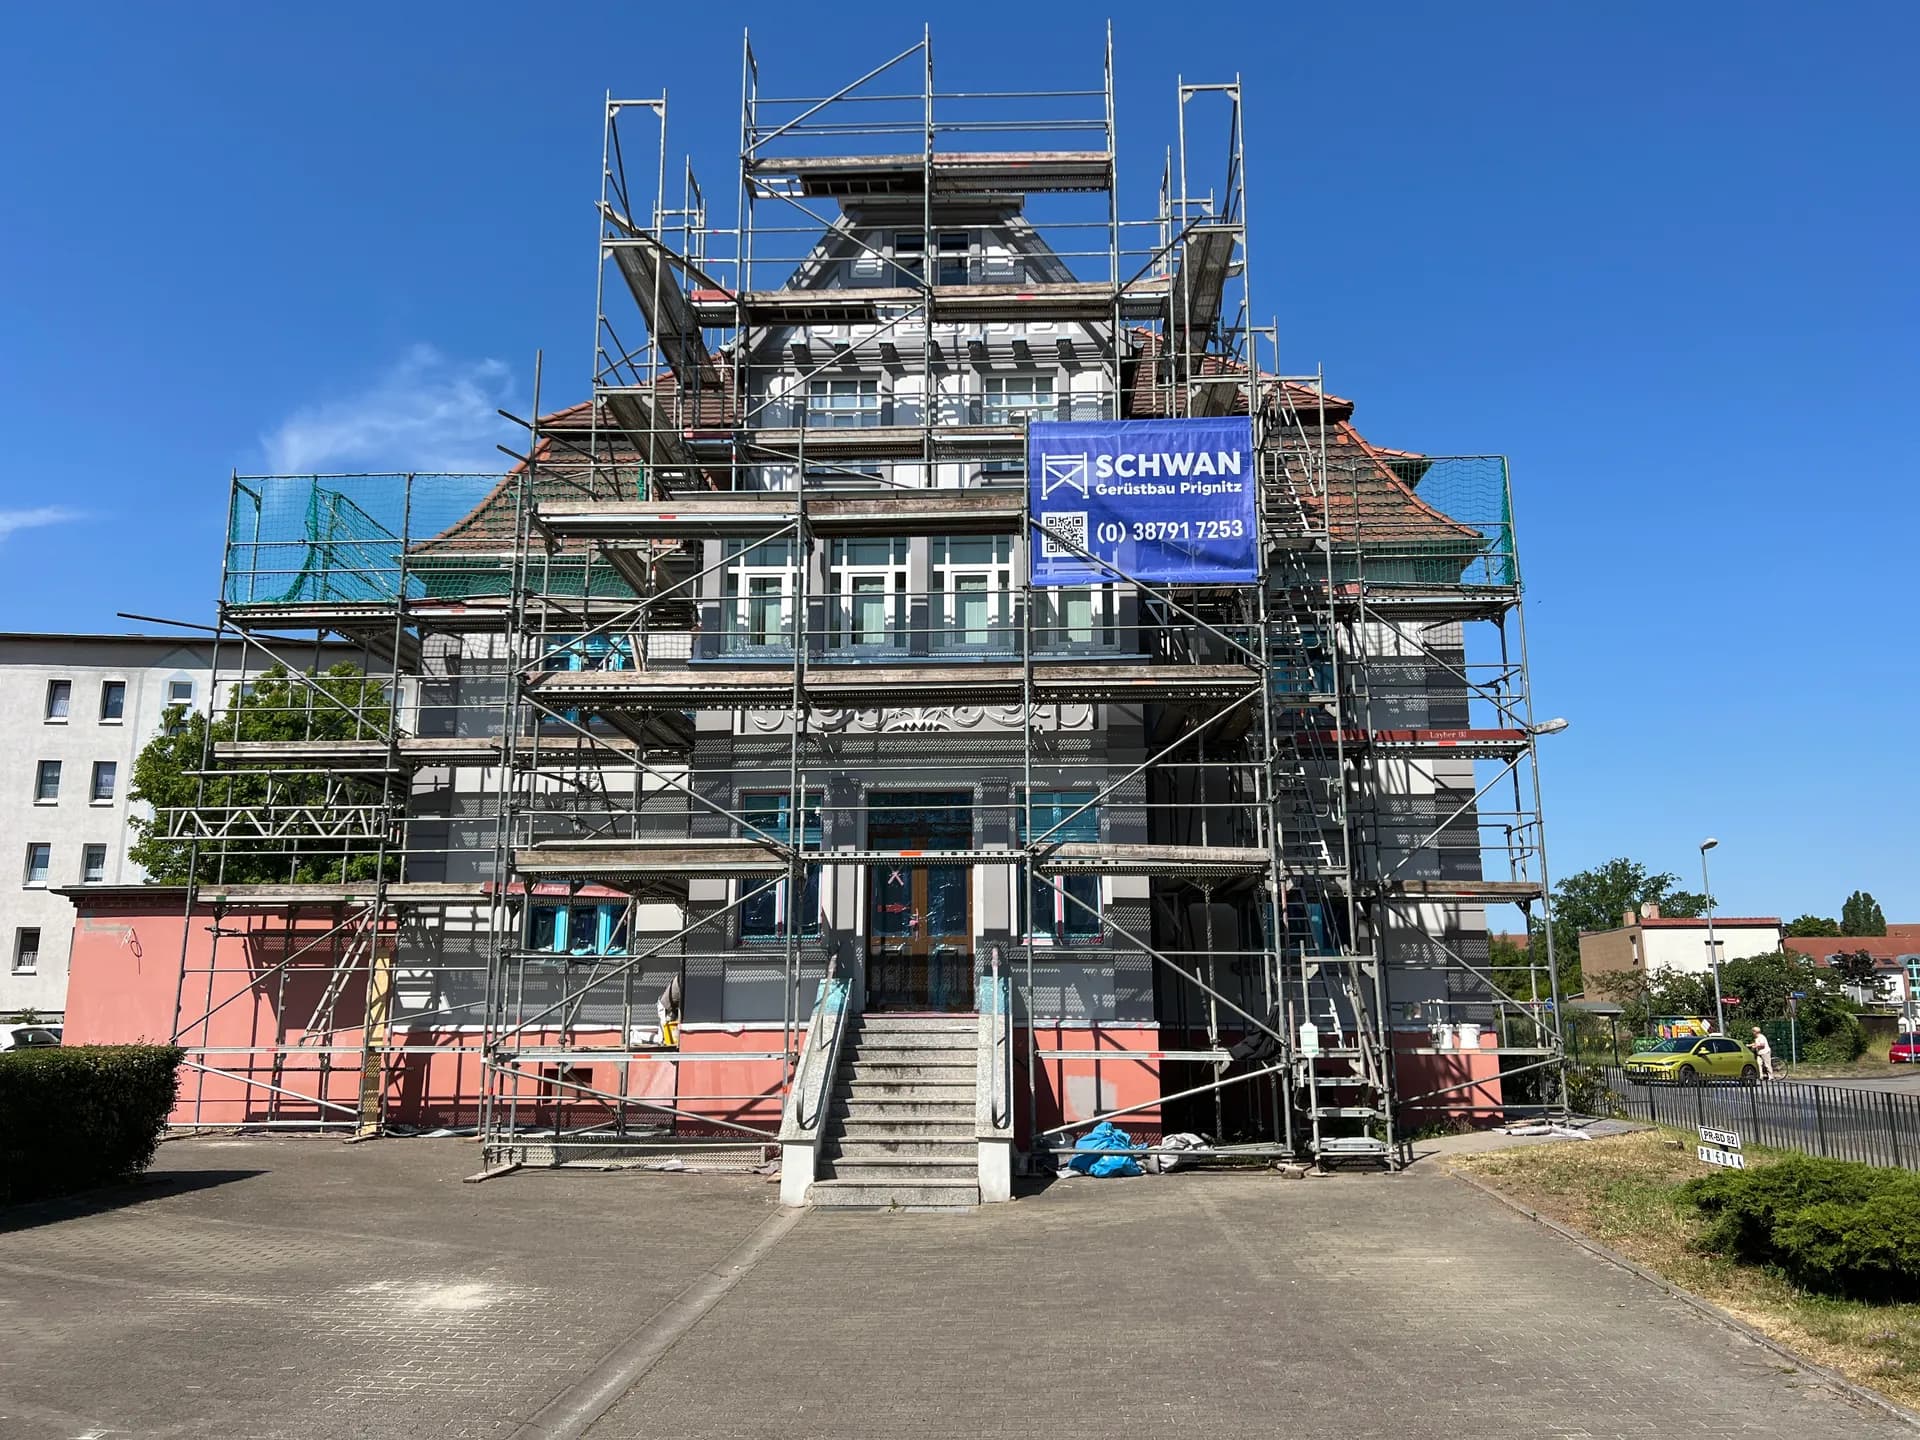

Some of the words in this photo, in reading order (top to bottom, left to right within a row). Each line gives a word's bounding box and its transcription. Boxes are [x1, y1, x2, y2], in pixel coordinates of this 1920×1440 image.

[1095, 451, 1241, 478] SCHWAN
[1096, 481, 1176, 496] Gerüstbau
[1180, 480, 1242, 496] Prignitz
[1096, 522, 1127, 544] (0)
[1133, 521, 1190, 541] 38791
[1196, 520, 1243, 539] 7253
